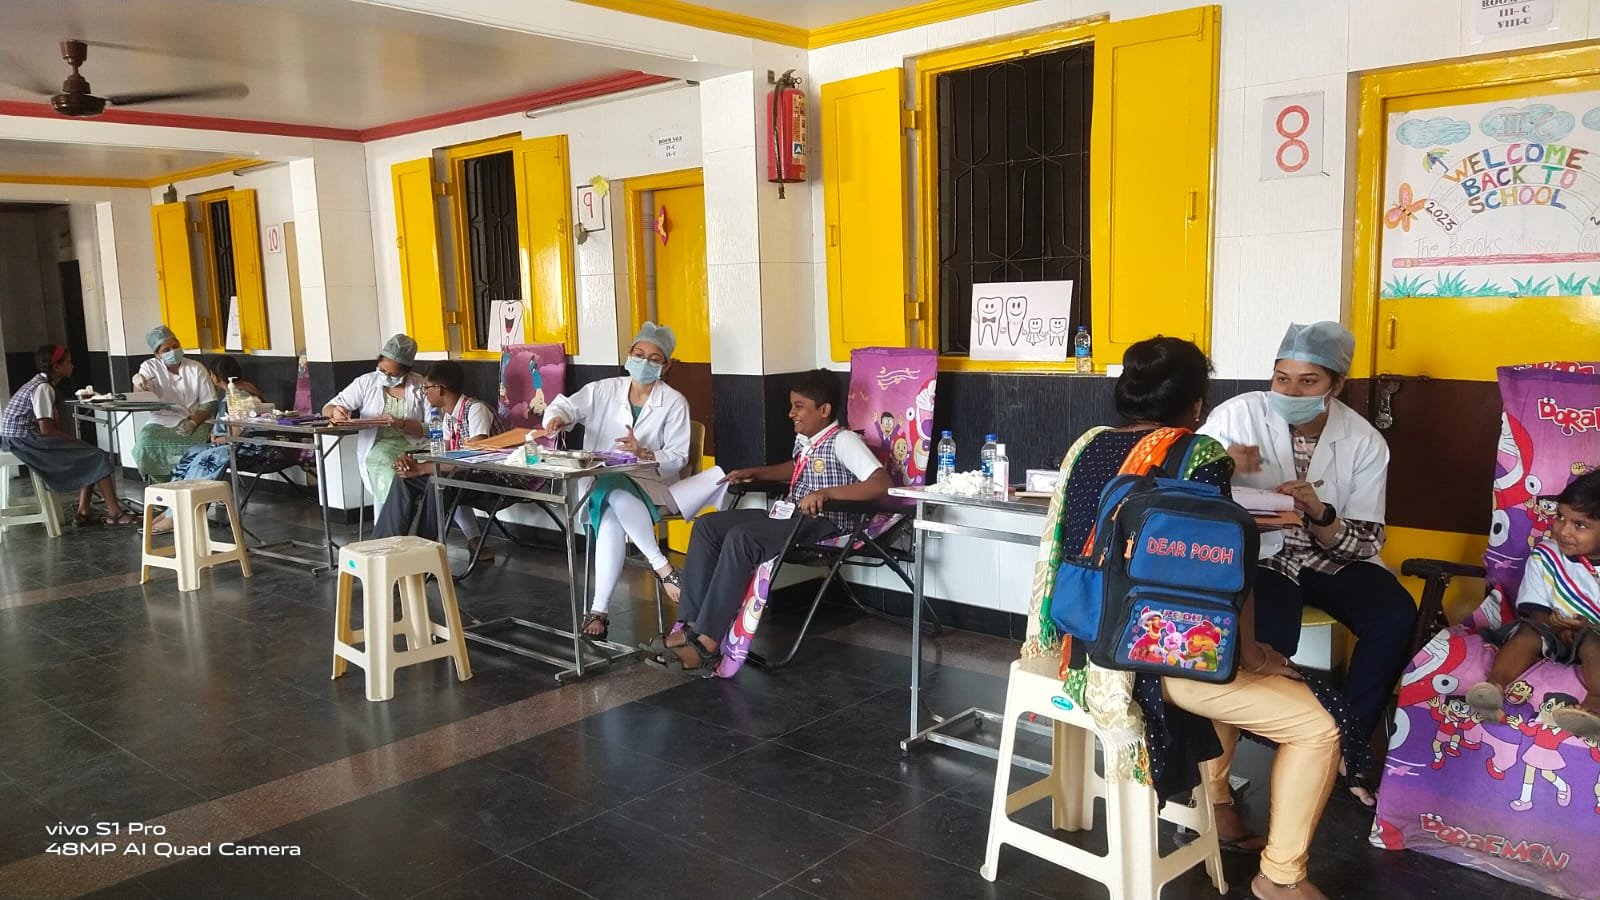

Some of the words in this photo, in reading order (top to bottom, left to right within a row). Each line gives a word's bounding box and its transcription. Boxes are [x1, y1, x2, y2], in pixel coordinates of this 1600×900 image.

[1497, 17, 1531, 28] VIII-C
[1276, 105, 1310, 173] 8
[1442, 143, 1588, 183] WELCOME
[1460, 164, 1528, 197] BACK
[1541, 165, 1577, 189] TO
[583, 192, 594, 219] 9
[1467, 185, 1567, 214] SCHOOL
[1425, 202, 1458, 232] 2023
[268, 227, 278, 252] 10
[1415, 237, 1440, 258] The
[1146, 537, 1187, 558] DEAR
[1190, 543, 1234, 565] POOH
[1162, 609, 1203, 622] POOH
